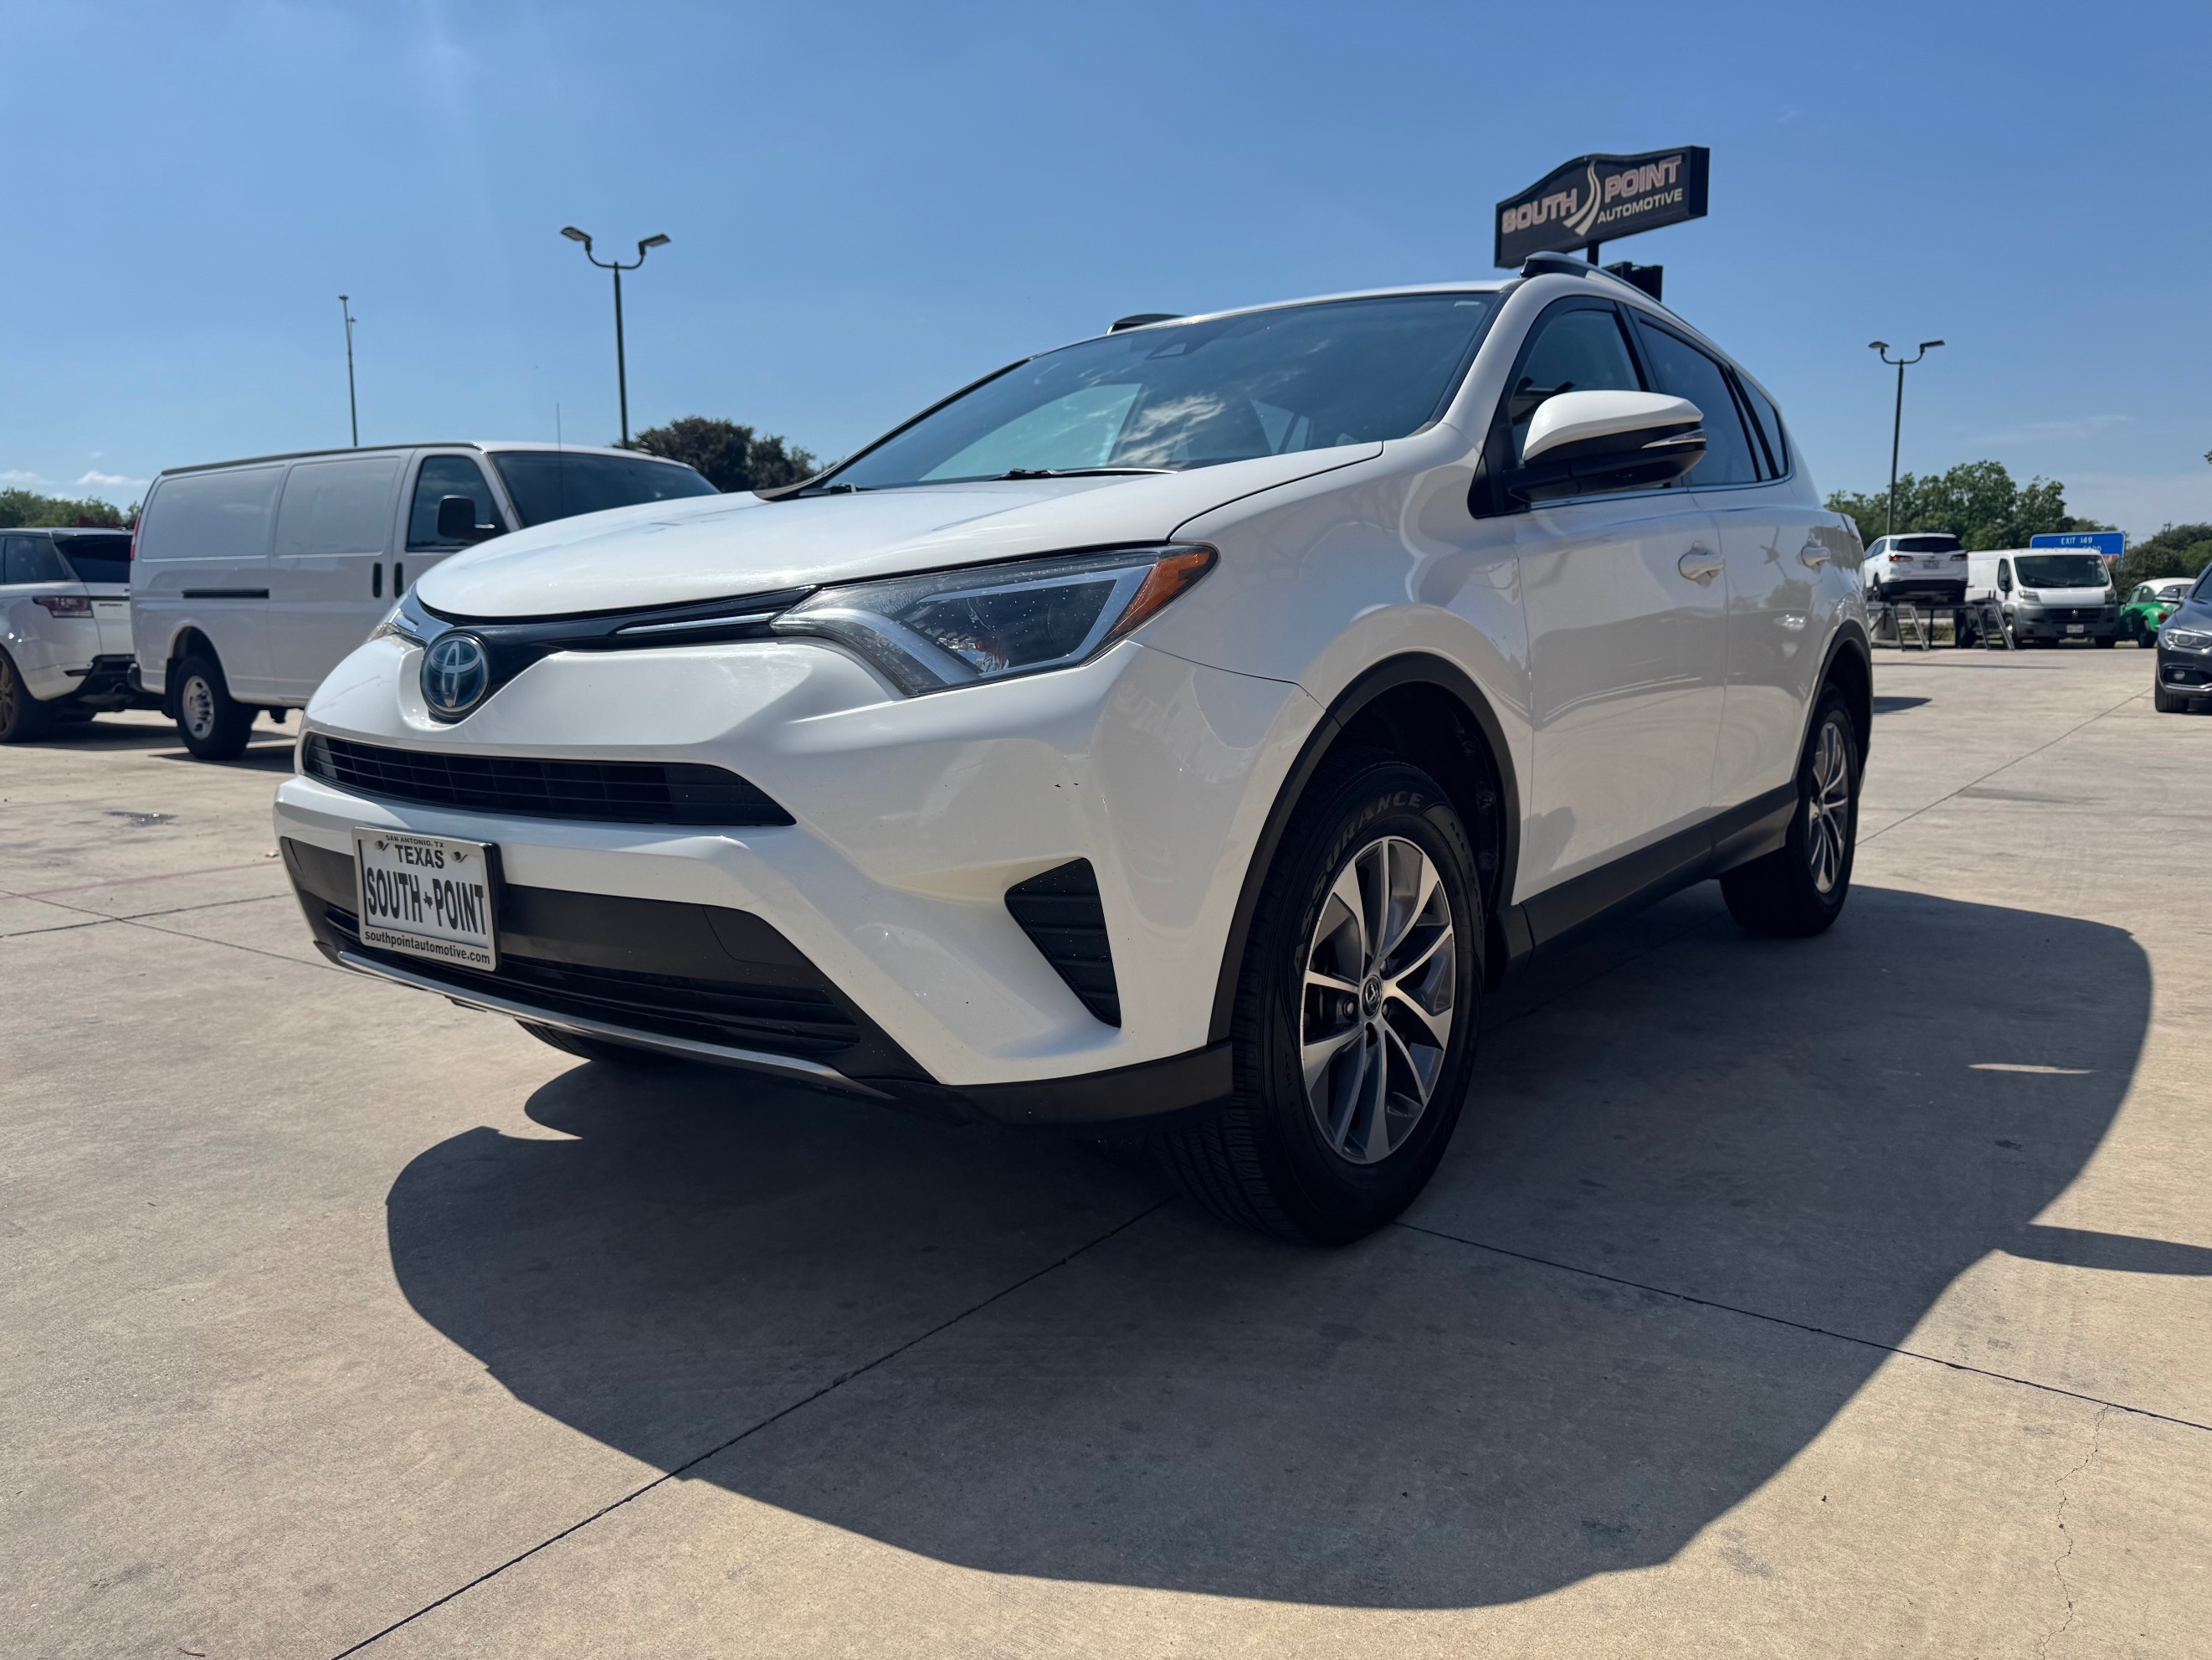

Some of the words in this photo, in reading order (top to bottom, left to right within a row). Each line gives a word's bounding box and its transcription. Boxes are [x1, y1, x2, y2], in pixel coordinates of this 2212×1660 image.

[1501, 188, 1578, 234] SOUTH
[1604, 154, 1682, 204] POINT
[1597, 188, 1683, 224] AUTOMOTIVE
[2061, 537, 2076, 545] EXIT
[394, 844, 445, 869] TEXAS
[367, 866, 423, 923] SOUTH
[432, 878, 486, 935] POINT
[1293, 789, 1424, 976] ASSURANCE
[365, 931, 490, 964] southpointautomotive.com
